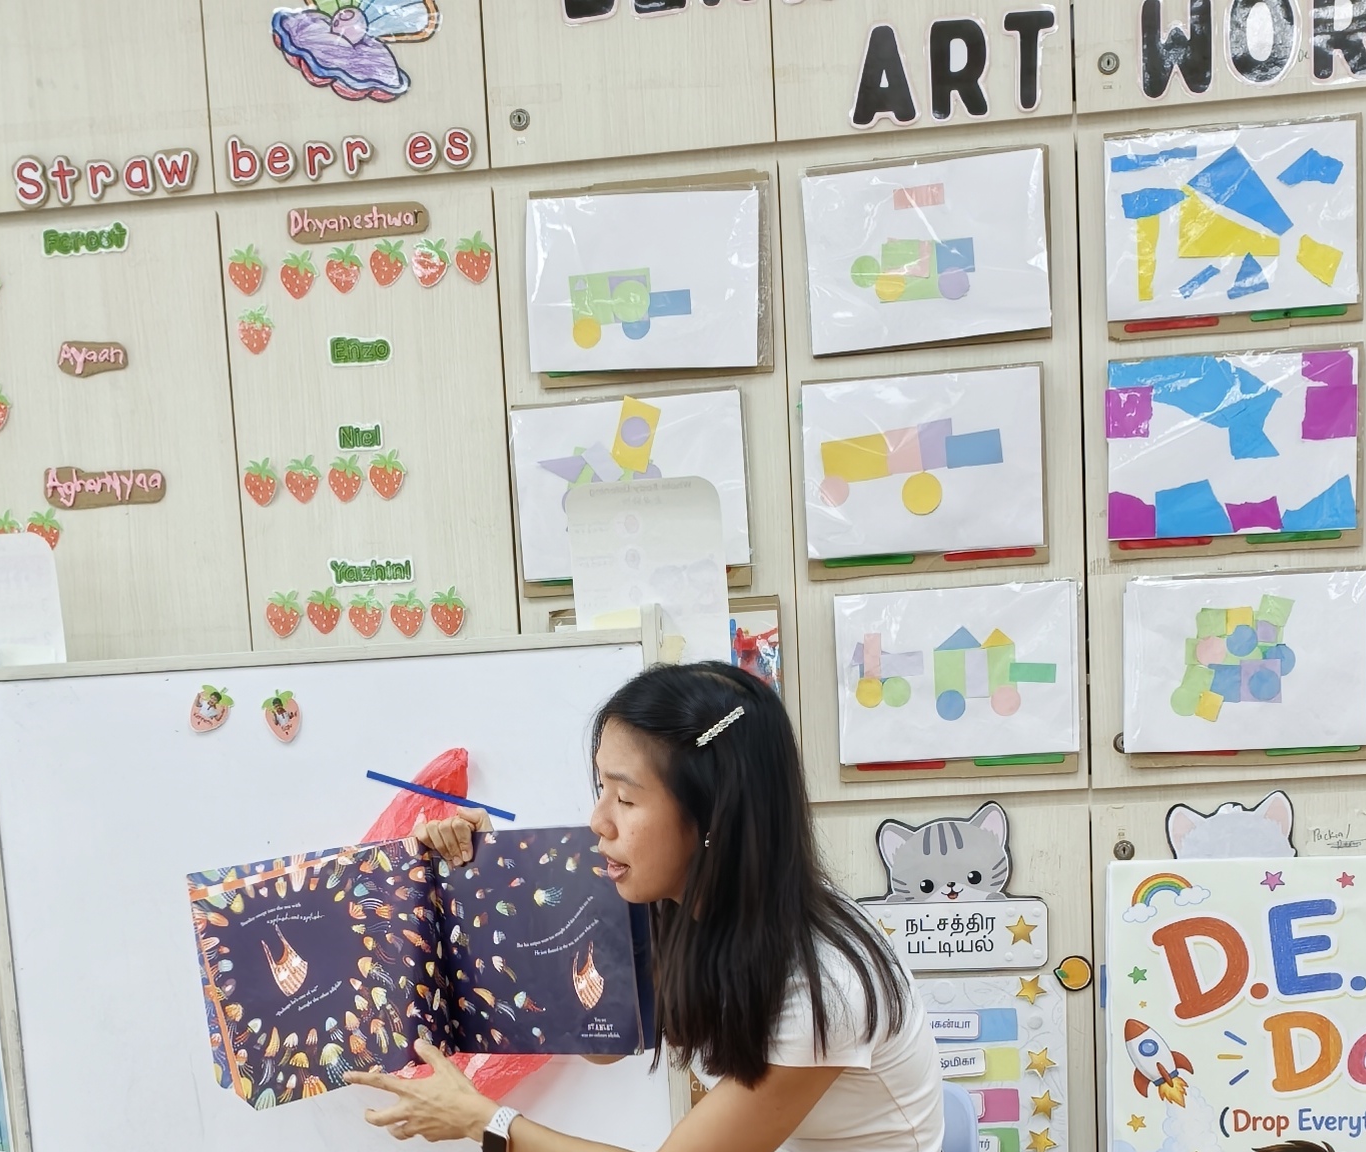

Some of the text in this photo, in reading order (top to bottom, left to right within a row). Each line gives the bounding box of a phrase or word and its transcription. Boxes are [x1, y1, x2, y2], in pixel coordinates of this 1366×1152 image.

[853, 11, 1055, 124] ART
[59, 343, 123, 374] Ayaan
[330, 337, 390, 364] Enzo
[337, 424, 382, 449] Niel
[905, 912, 996, 937] நட்சத்திர
[907, 935, 994, 957] பட்டியல்
[930, 1018, 971, 1030] கன்யா
[1219, 1107, 1289, 1138] (Drop
